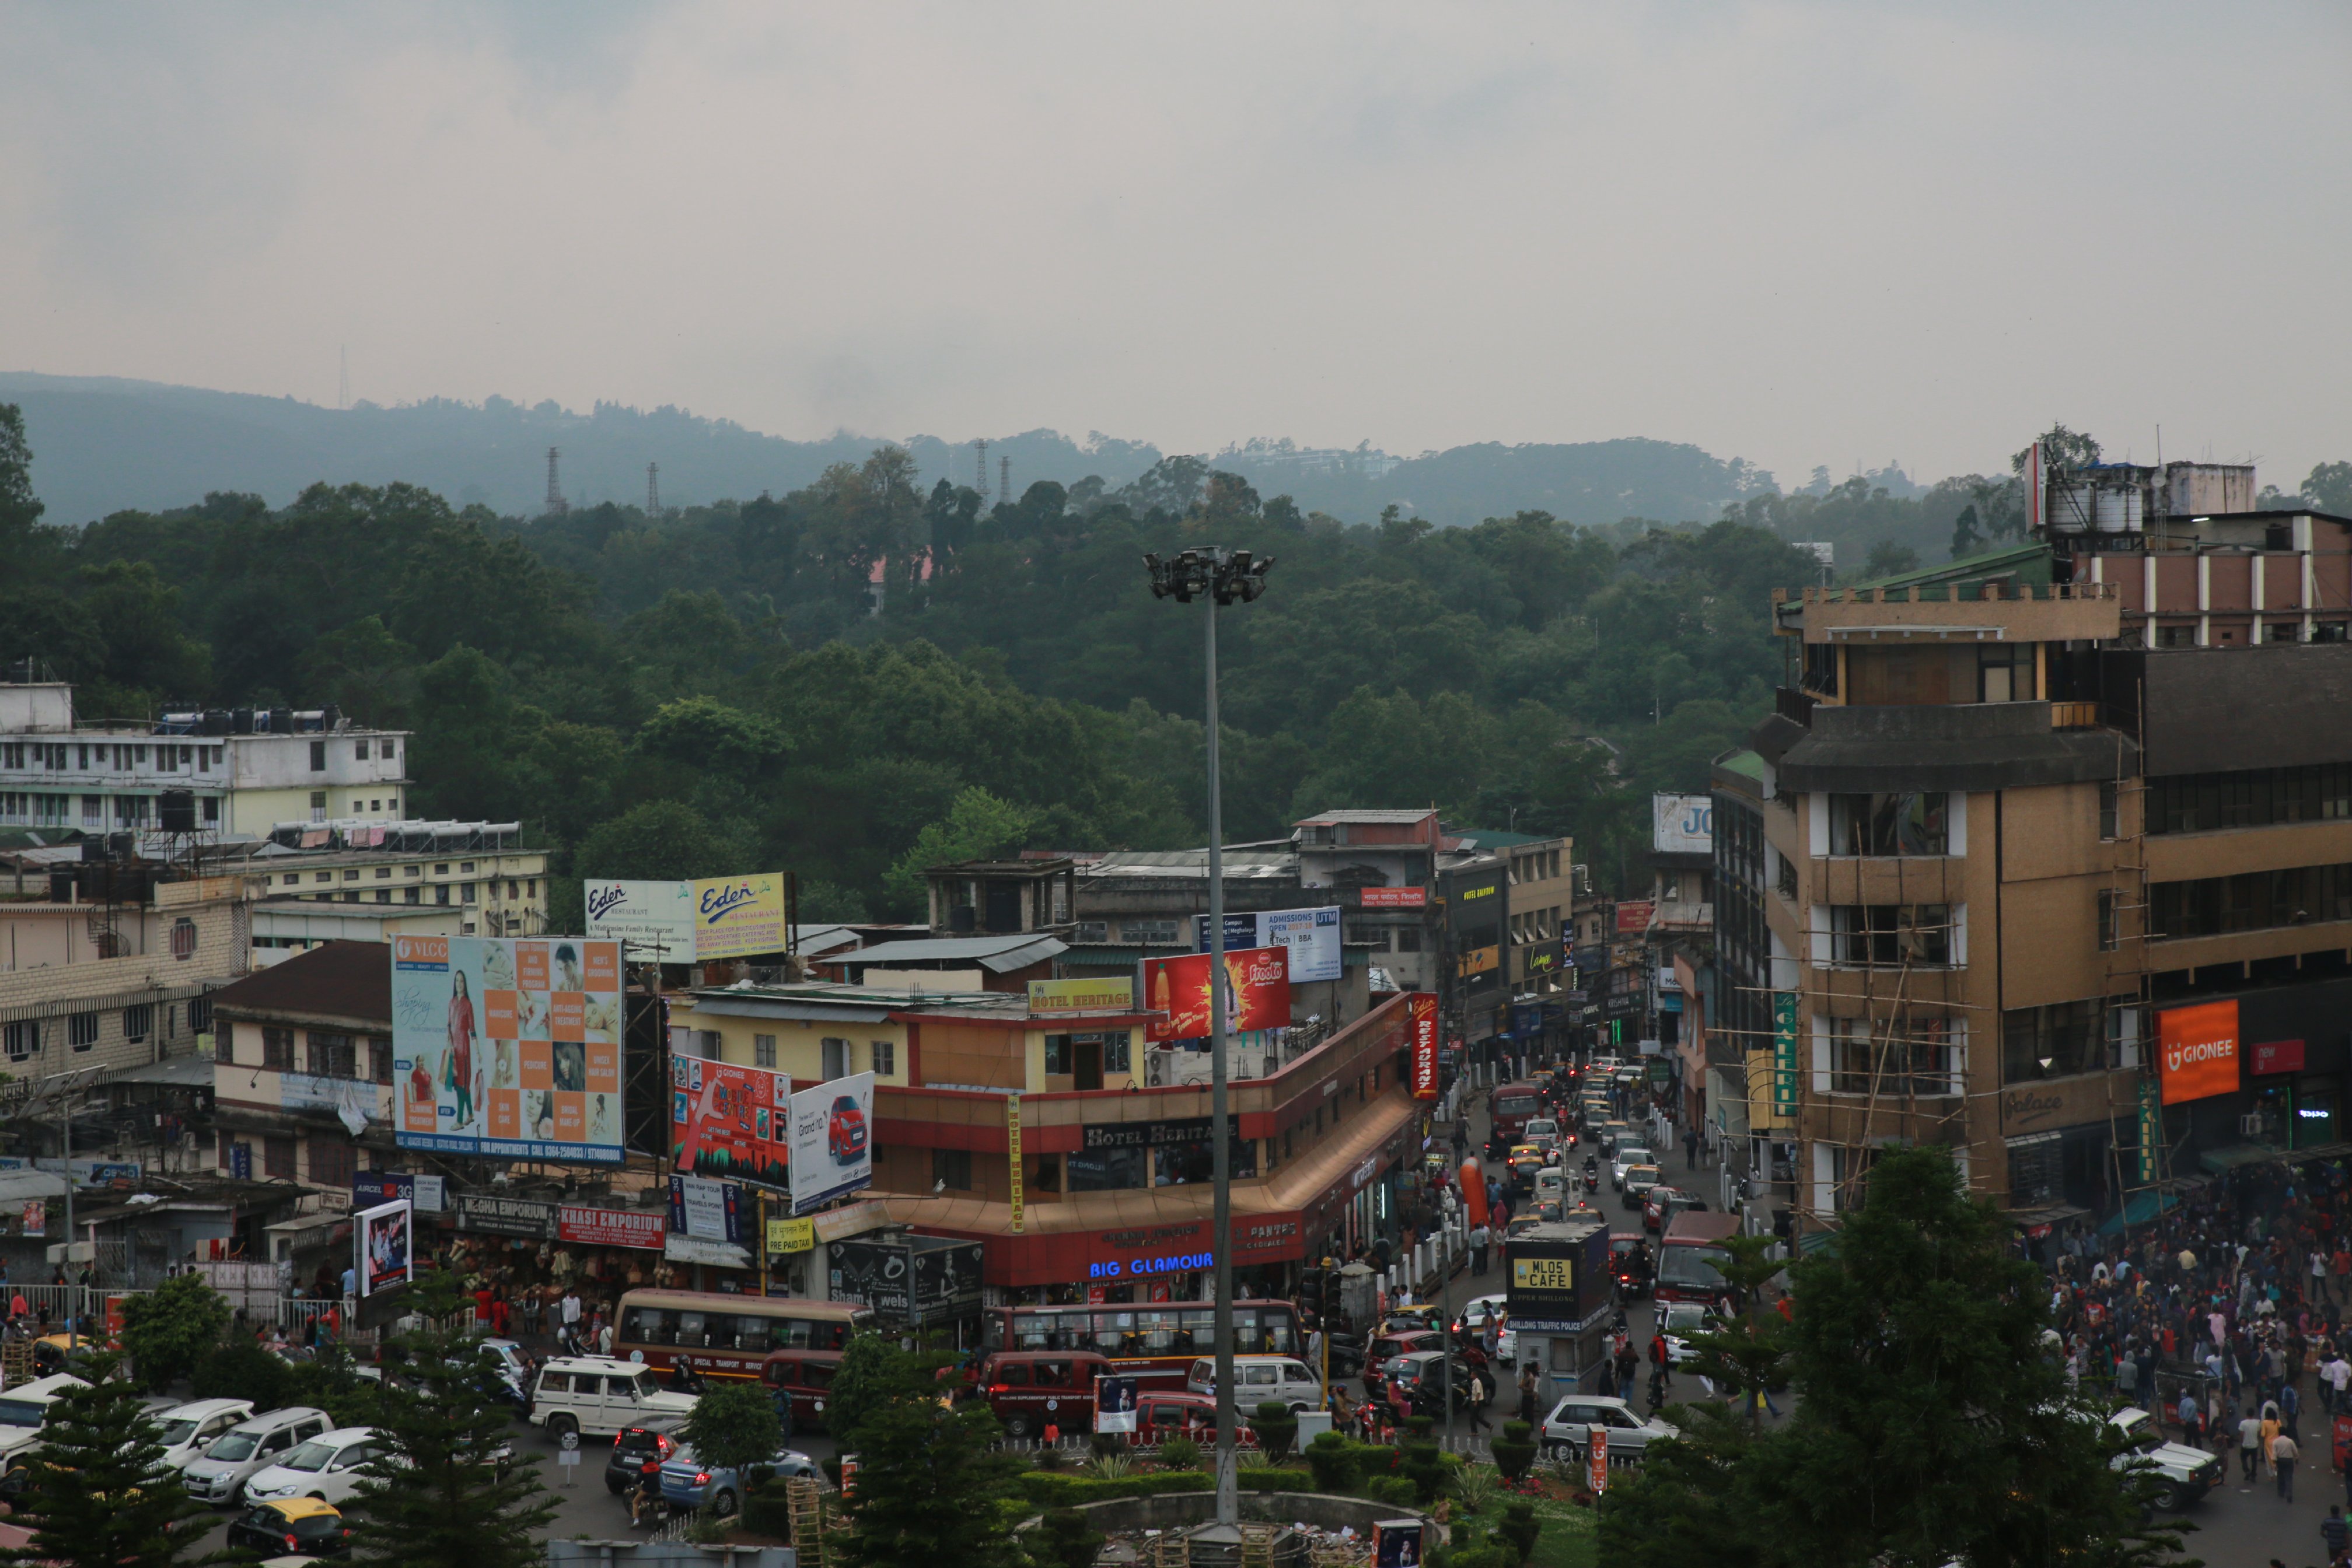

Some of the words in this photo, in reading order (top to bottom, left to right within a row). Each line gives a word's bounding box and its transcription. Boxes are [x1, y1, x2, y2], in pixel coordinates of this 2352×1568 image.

[588, 886, 627, 914] Eden
[700, 884, 756, 914] Eden
[1463, 891, 1476, 901] HOTEL
[729, 909, 780, 920] RESTAURANT
[1269, 913, 1312, 923] ADMISSIONS
[1317, 912, 1336, 923] UTM
[625, 926, 642, 934] Family
[1269, 923, 1287, 932] OPEN
[1288, 923, 1312, 931] 2017-18
[1298, 934, 1312, 943] BBA
[415, 942, 448, 957] VLCC
[517, 943, 530, 951] BODY
[593, 956, 608, 965] MEN'S
[588, 969, 614, 978] GROOMING
[1249, 963, 1282, 982] Frooto
[522, 979, 545, 989] PROGRAM
[394, 985, 435, 1027] Shaping
[1032, 996, 1069, 1007] HOTEL
[1073, 993, 1130, 1006] HERITAGE
[1608, 996, 1629, 1008] KRISHNA
[1413, 999, 1436, 1016] Eden
[555, 1016, 581, 1026] TREATMENT
[1417, 1020, 1431, 1089] RESTAURANT
[2183, 1039, 2233, 1063] GIONEE
[2259, 1046, 2275, 1059] new
[523, 1060, 547, 1070] PEDICURE
[593, 1056, 610, 1065] UNISEX
[588, 1068, 599, 1076] HAIR
[600, 1068, 614, 1077] SALON
[723, 1069, 745, 1079] GIONEE
[719, 1085, 749, 1104] MOBILE
[410, 1105, 432, 1114] SLIMMING
[499, 1102, 509, 1111] SKIN
[561, 1105, 578, 1114] BRIDAL
[718, 1101, 749, 1119] CENTRE
[409, 1116, 434, 1126] TREATMENT
[498, 1115, 511, 1124] CARE
[559, 1118, 580, 1126] MAKE-UP
[799, 1121, 815, 1136] Grand
[815, 1118, 824, 1131] i10.
[1009, 1112, 1019, 1154] HOTEL
[1086, 1128, 1144, 1147] HOTEL
[1149, 1125, 1237, 1143] HERITAE
[481, 1142, 490, 1153] FOR
[491, 1143, 529, 1156] APPOINTMENTS
[532, 1145, 544, 1156] CALL
[357, 1184, 382, 1194] AIRCEL
[397, 1185, 413, 1199] 3G
[672, 1178, 679, 1192] 3G
[727, 1186, 734, 1200] 3G
[1011, 1161, 1022, 1230] HERITAGE
[465, 1198, 497, 1214] MEGHA
[499, 1201, 548, 1220] EMPORIUM
[686, 1199, 707, 1208] TRAVELS
[561, 1209, 597, 1226] KHASI
[600, 1212, 663, 1232] EMPORIUM
[770, 1241, 782, 1250] PRE
[783, 1241, 798, 1250] PAID
[799, 1238, 810, 1248] TAXI
[1090, 1261, 1120, 1278] BIG
[1130, 1252, 1214, 1274] GLAMOUR
[1530, 1274, 1566, 1287] CAFE
[831, 1289, 864, 1304] Sham
[916, 1302, 930, 1311] Sham
[931, 1298, 948, 1308] Jewels
[1509, 1320, 1536, 1329] SHILLONG
[1537, 1321, 1560, 1330] TRAFFIC
[1561, 1322, 1581, 1331] POLICE
[694, 1357, 711, 1367] SPECIAL
[716, 1359, 739, 1368] TRANSPORT
[745, 1362, 761, 1370] SERVICE
